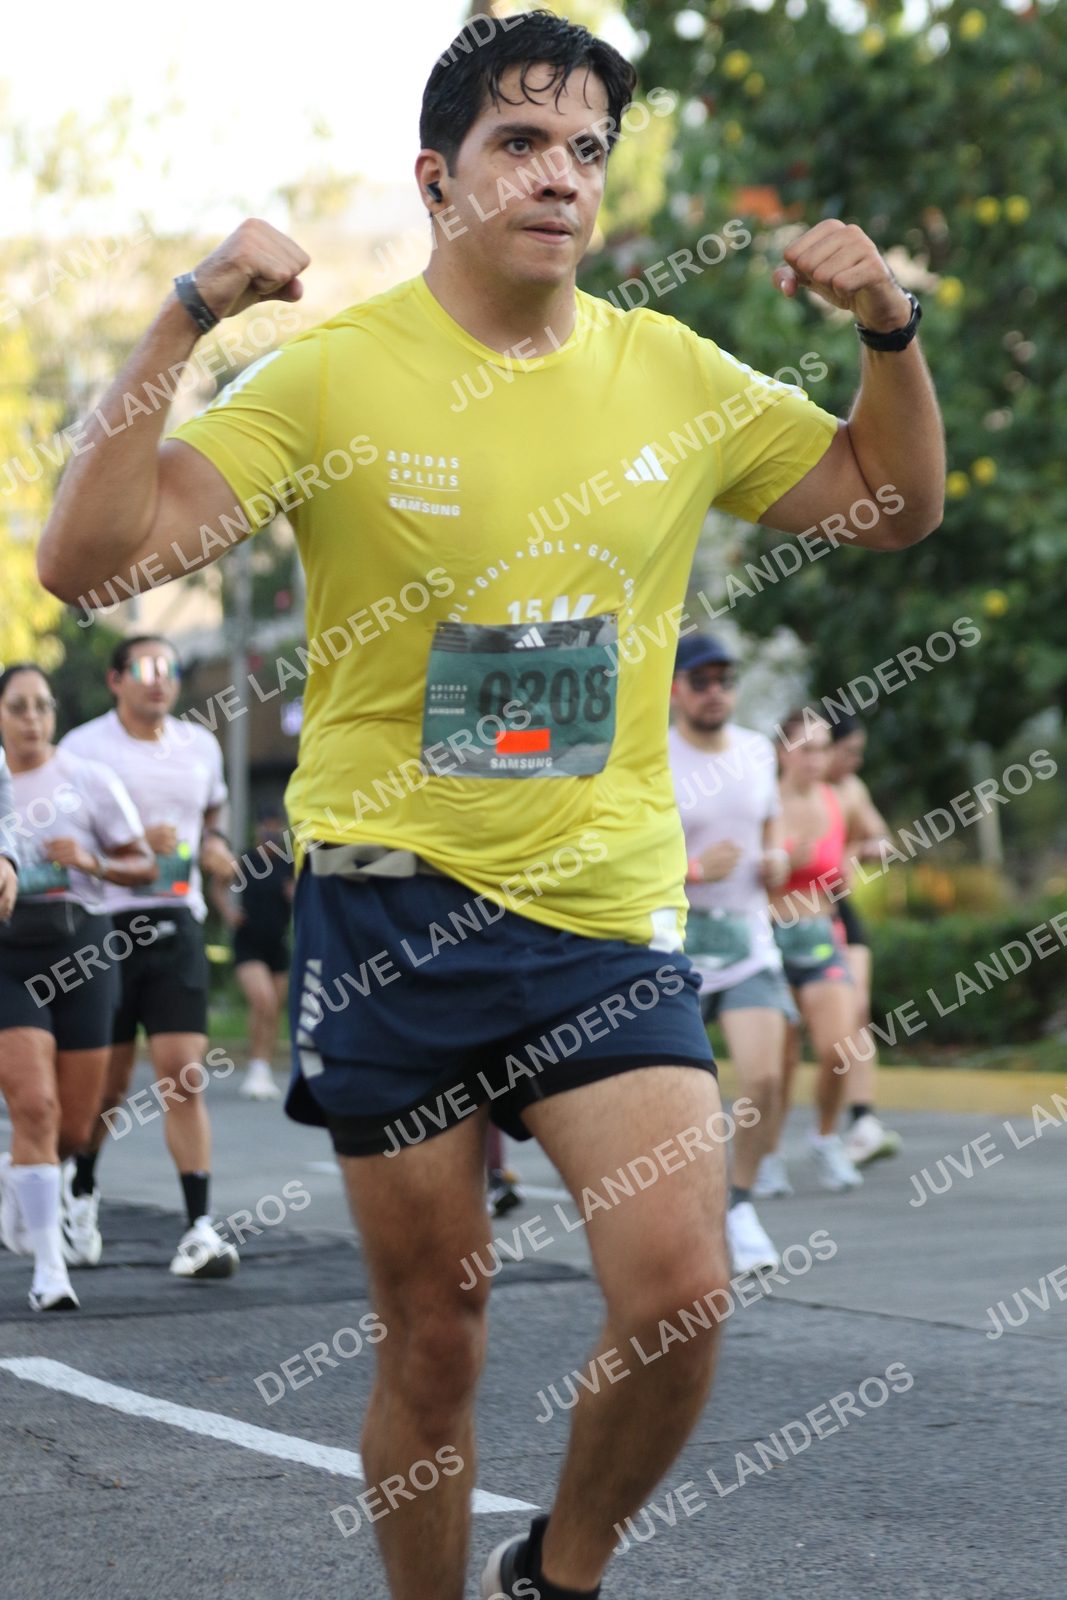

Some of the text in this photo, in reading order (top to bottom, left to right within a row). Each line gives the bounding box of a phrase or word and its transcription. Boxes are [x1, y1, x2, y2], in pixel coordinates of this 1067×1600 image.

[387, 449, 459, 469] ADIDAS
[389, 467, 459, 487] SPLITS
[389, 496, 461, 517] SAMSUNG
[528, 540, 567, 558] GDL
[478, 664, 612, 727] 0208
[490, 757, 553, 770] SAMSUNG
